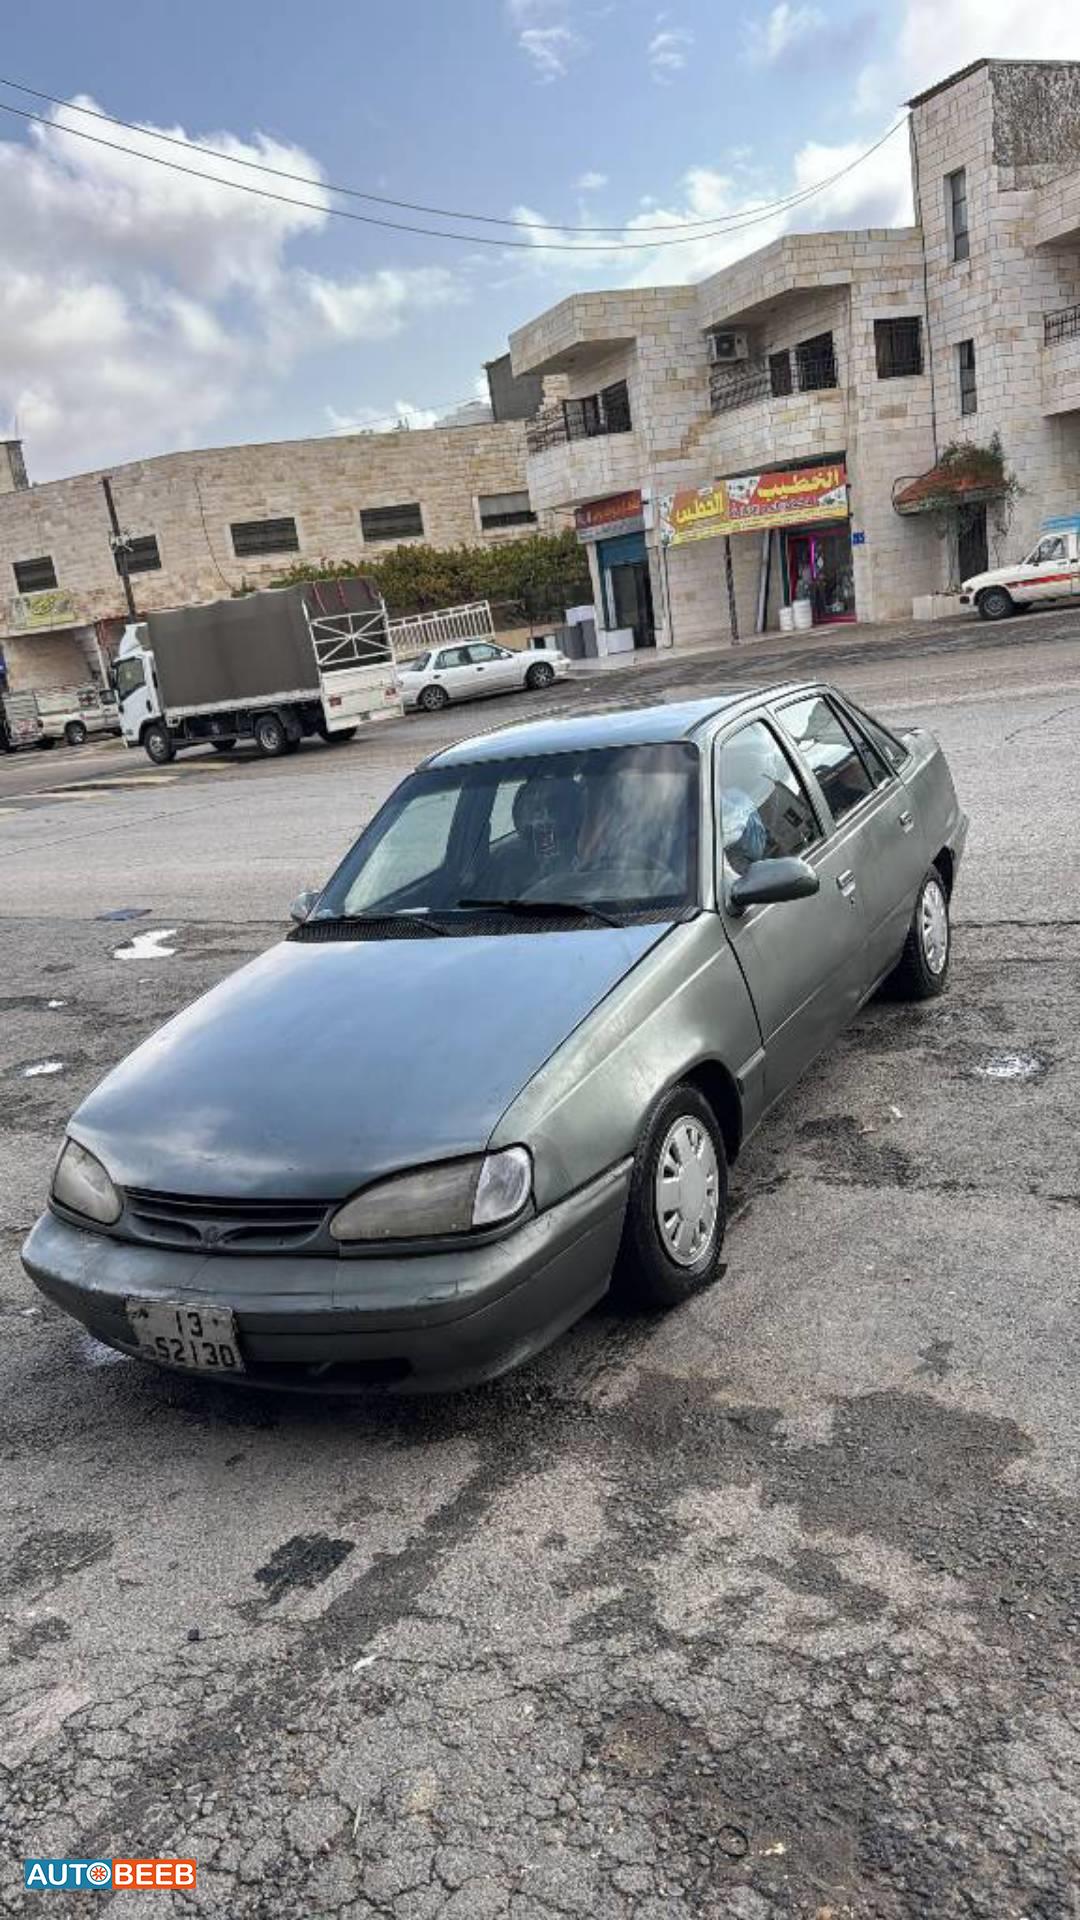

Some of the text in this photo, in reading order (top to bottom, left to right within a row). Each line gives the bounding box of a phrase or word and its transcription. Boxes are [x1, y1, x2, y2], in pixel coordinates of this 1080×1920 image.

[756, 470, 839, 501] الخطيب
[175, 1310, 203, 1338] 13
[155, 1336, 236, 1368] 52130
